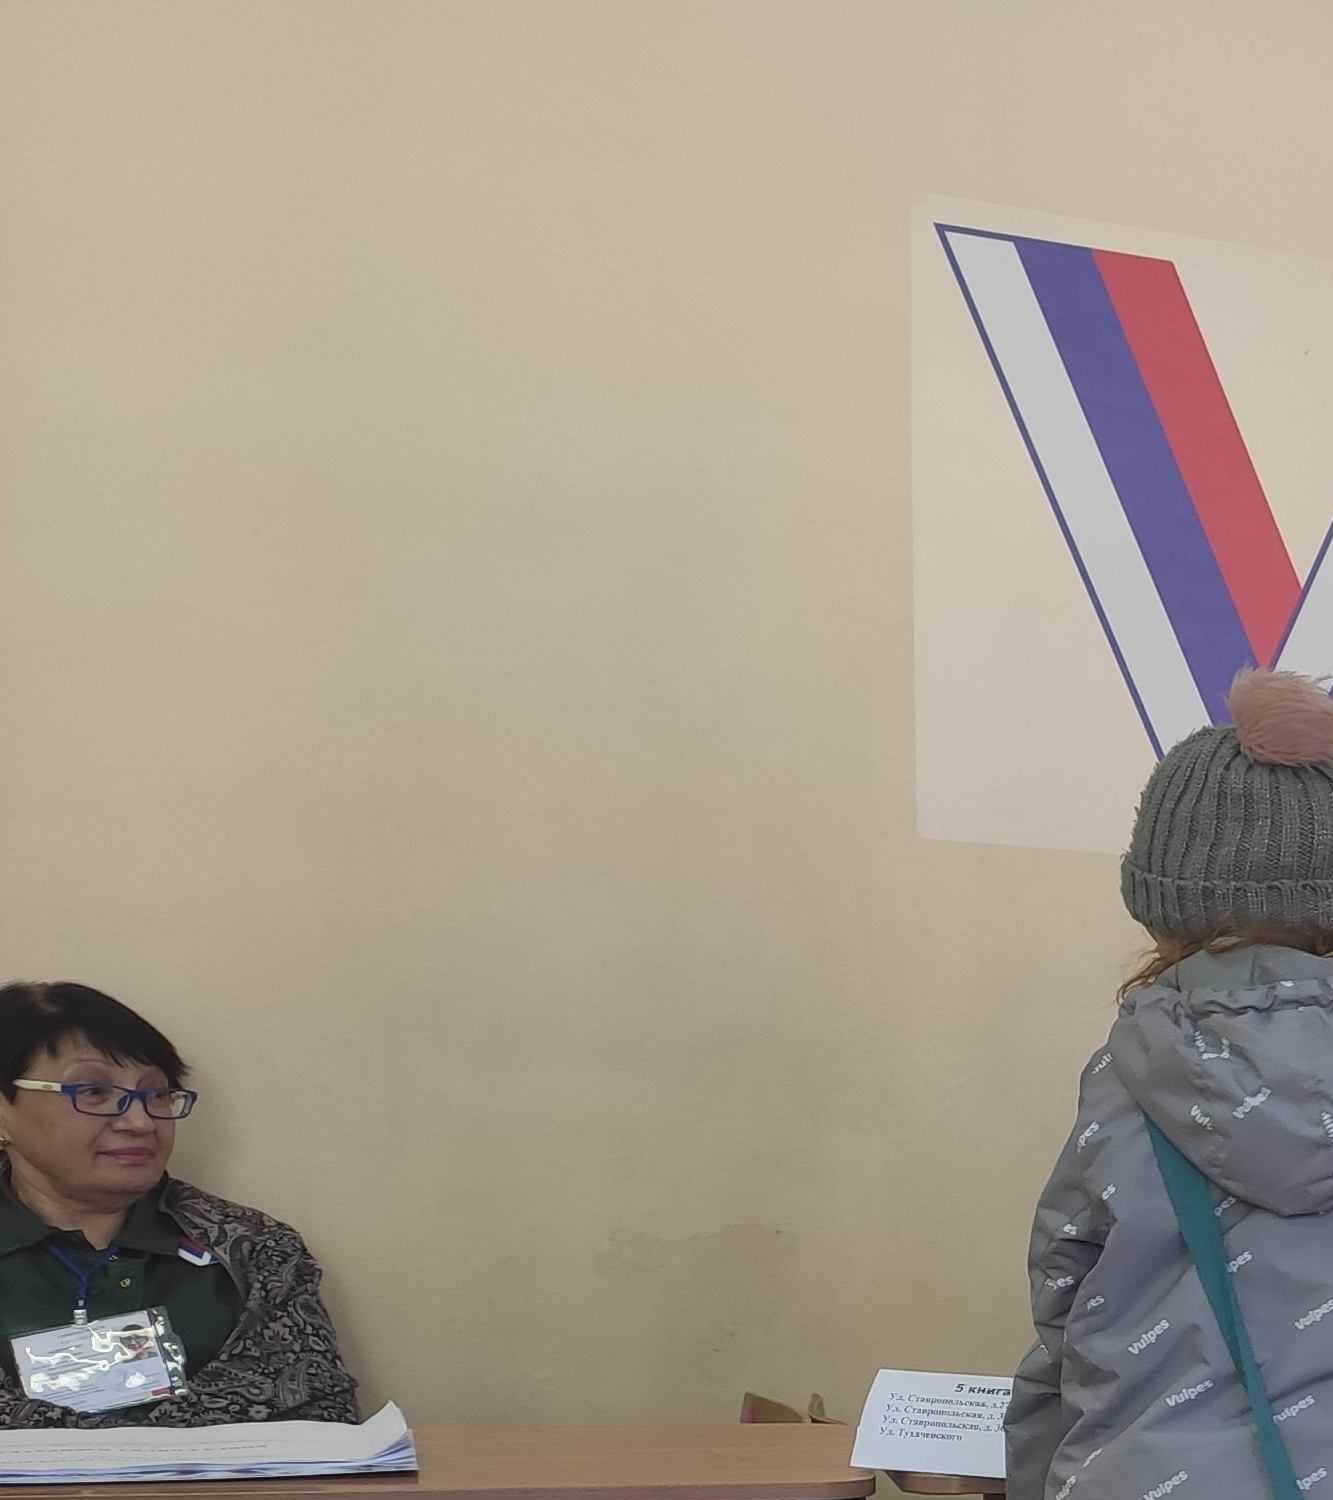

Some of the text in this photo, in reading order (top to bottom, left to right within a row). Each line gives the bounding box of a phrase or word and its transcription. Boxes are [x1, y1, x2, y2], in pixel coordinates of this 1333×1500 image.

[1226, 1250, 1254, 1274] pes
[1127, 1318, 1171, 1356] Vulpes
[954, 1382, 1012, 1397] 5 книга
[1164, 1379, 1215, 1408] Vulpes
[1295, 1466, 1329, 1491] lpes
